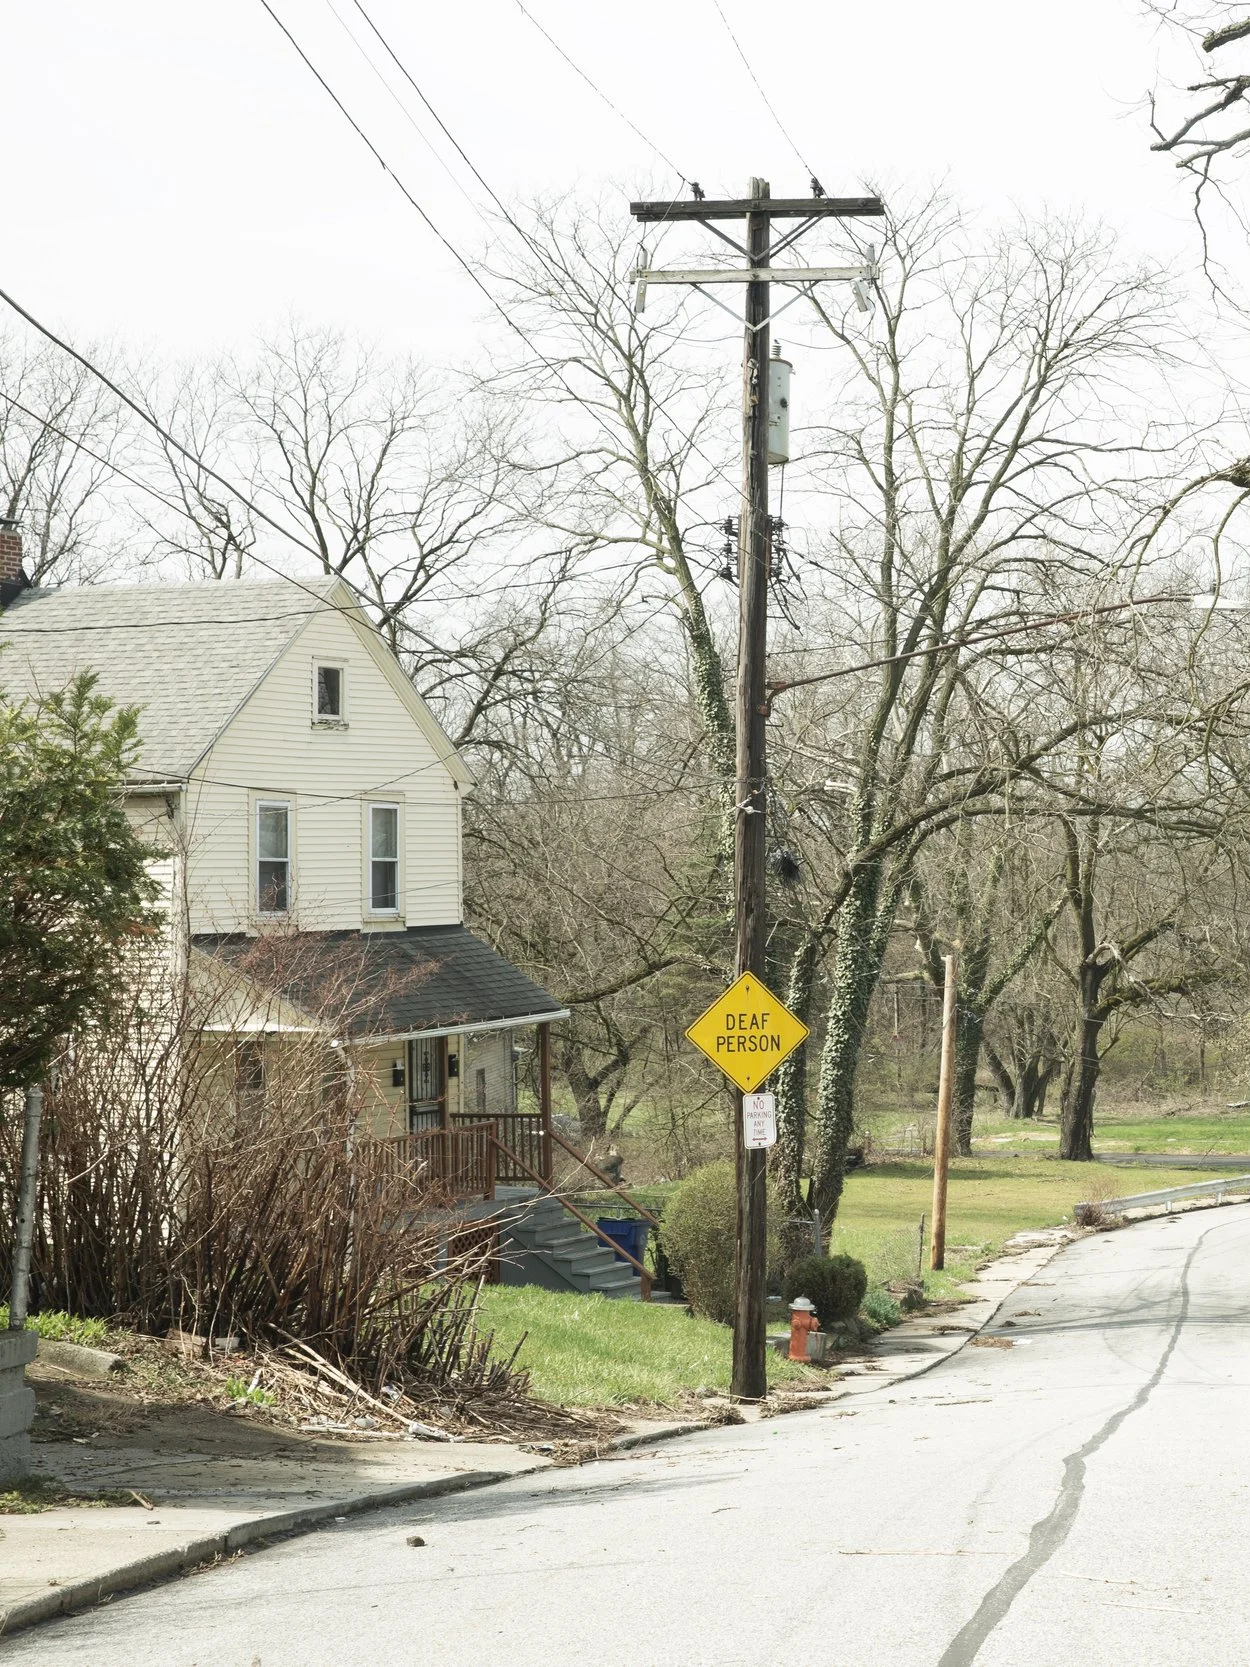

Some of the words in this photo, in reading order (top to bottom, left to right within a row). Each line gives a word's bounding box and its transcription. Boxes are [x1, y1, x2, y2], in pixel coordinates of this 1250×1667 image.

[725, 1013, 770, 1031] DEAF
[716, 1034, 781, 1053] PERSON
[752, 1100, 765, 1110] NO
[746, 1111, 772, 1119] PARKING
[753, 1128, 766, 1136] TIME
